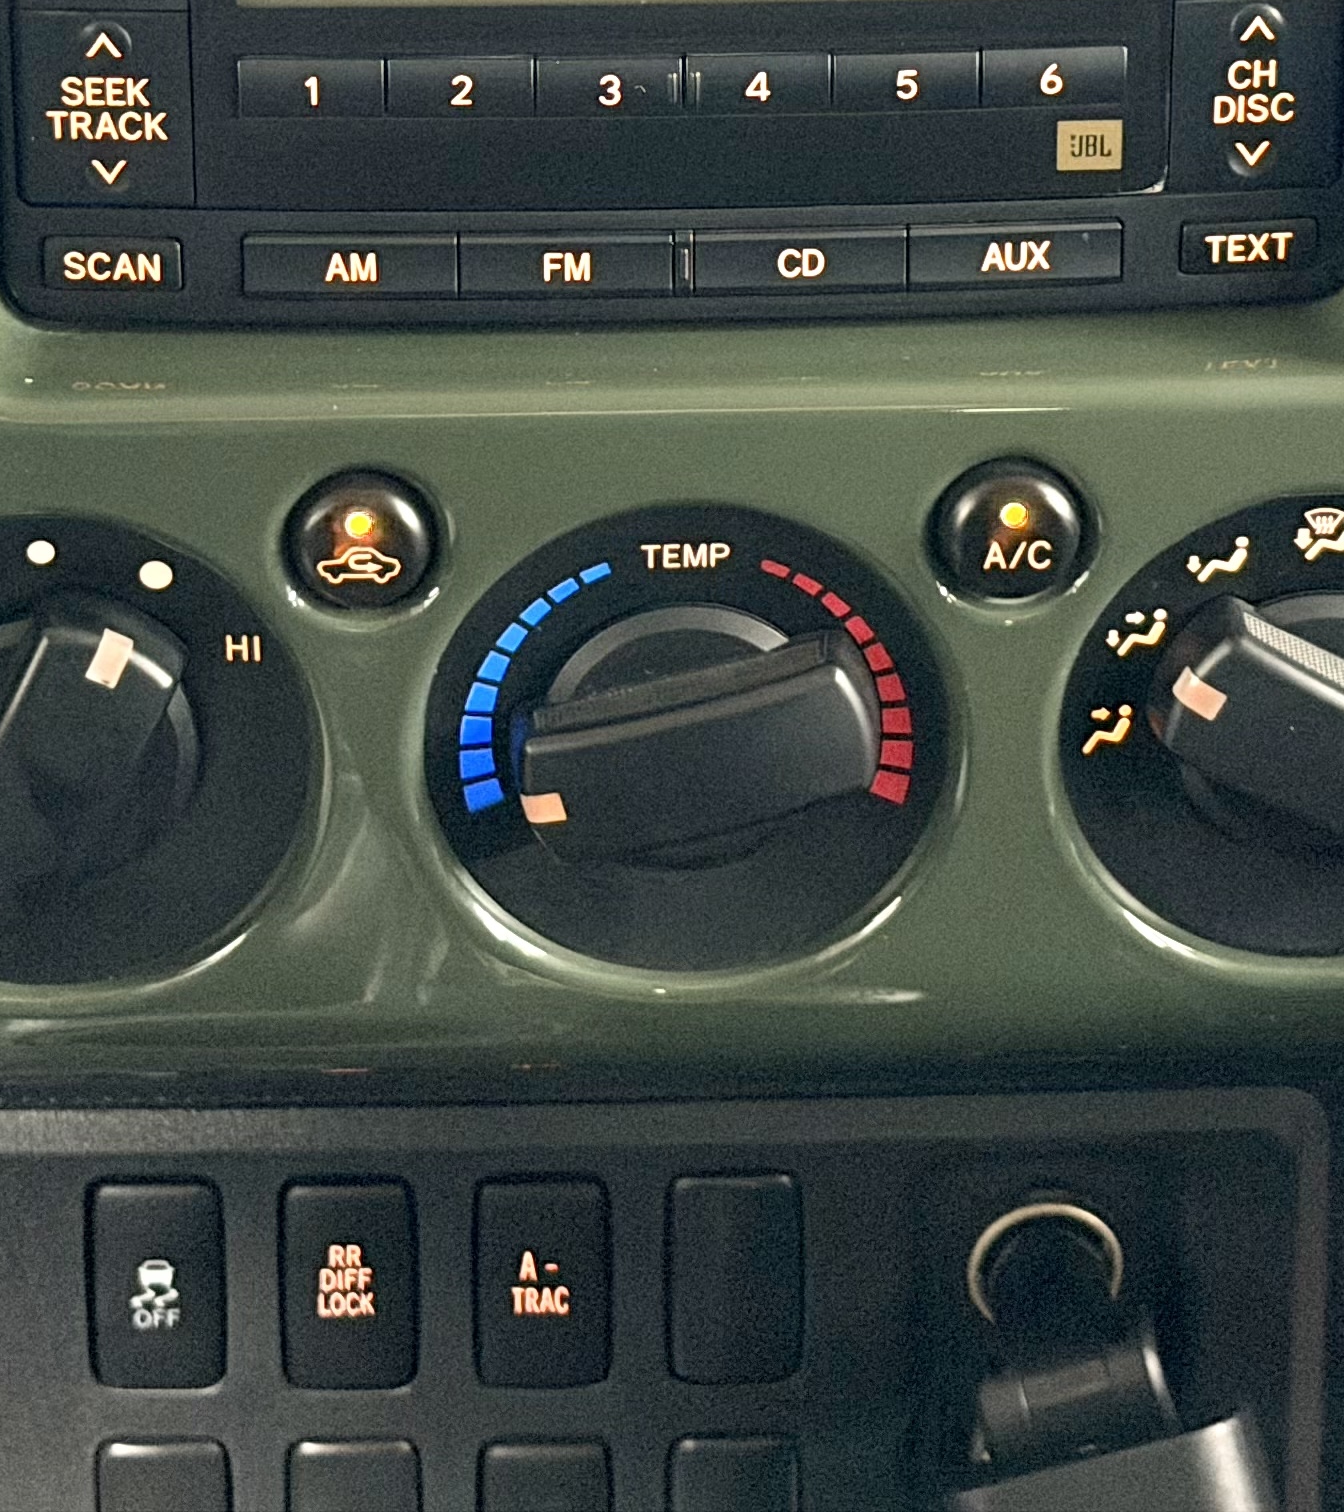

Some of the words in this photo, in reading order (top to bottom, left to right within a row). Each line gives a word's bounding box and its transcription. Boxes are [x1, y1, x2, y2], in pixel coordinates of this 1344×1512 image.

[745, 71, 771, 102] 4
[896, 69, 918, 100] 5
[1040, 63, 1064, 94] 6
[1227, 60, 1277, 88] CH
[61, 77, 150, 107] SEEK
[304, 76, 319, 106] 1
[450, 75, 473, 106] 2
[598, 75, 622, 106] 3
[1212, 94, 1294, 124] DISC
[46, 111, 168, 141] TRACK
[1070, 134, 1112, 157] JBL
[981, 241, 1051, 271] AUX
[1205, 232, 1294, 262] TEXT
[63, 251, 161, 281] SCAN
[325, 251, 378, 282] AM
[542, 252, 592, 282] FM
[777, 248, 826, 278] CD
[641, 543, 731, 570] TEMP
[983, 540, 1052, 571] A/C
[225, 634, 262, 662] HI
[328, 1244, 362, 1267] RR
[319, 1267, 371, 1291] DIFF
[317, 1291, 375, 1317] LOCK
[511, 1285, 570, 1314] TRAC
[132, 1308, 180, 1329] OFF
